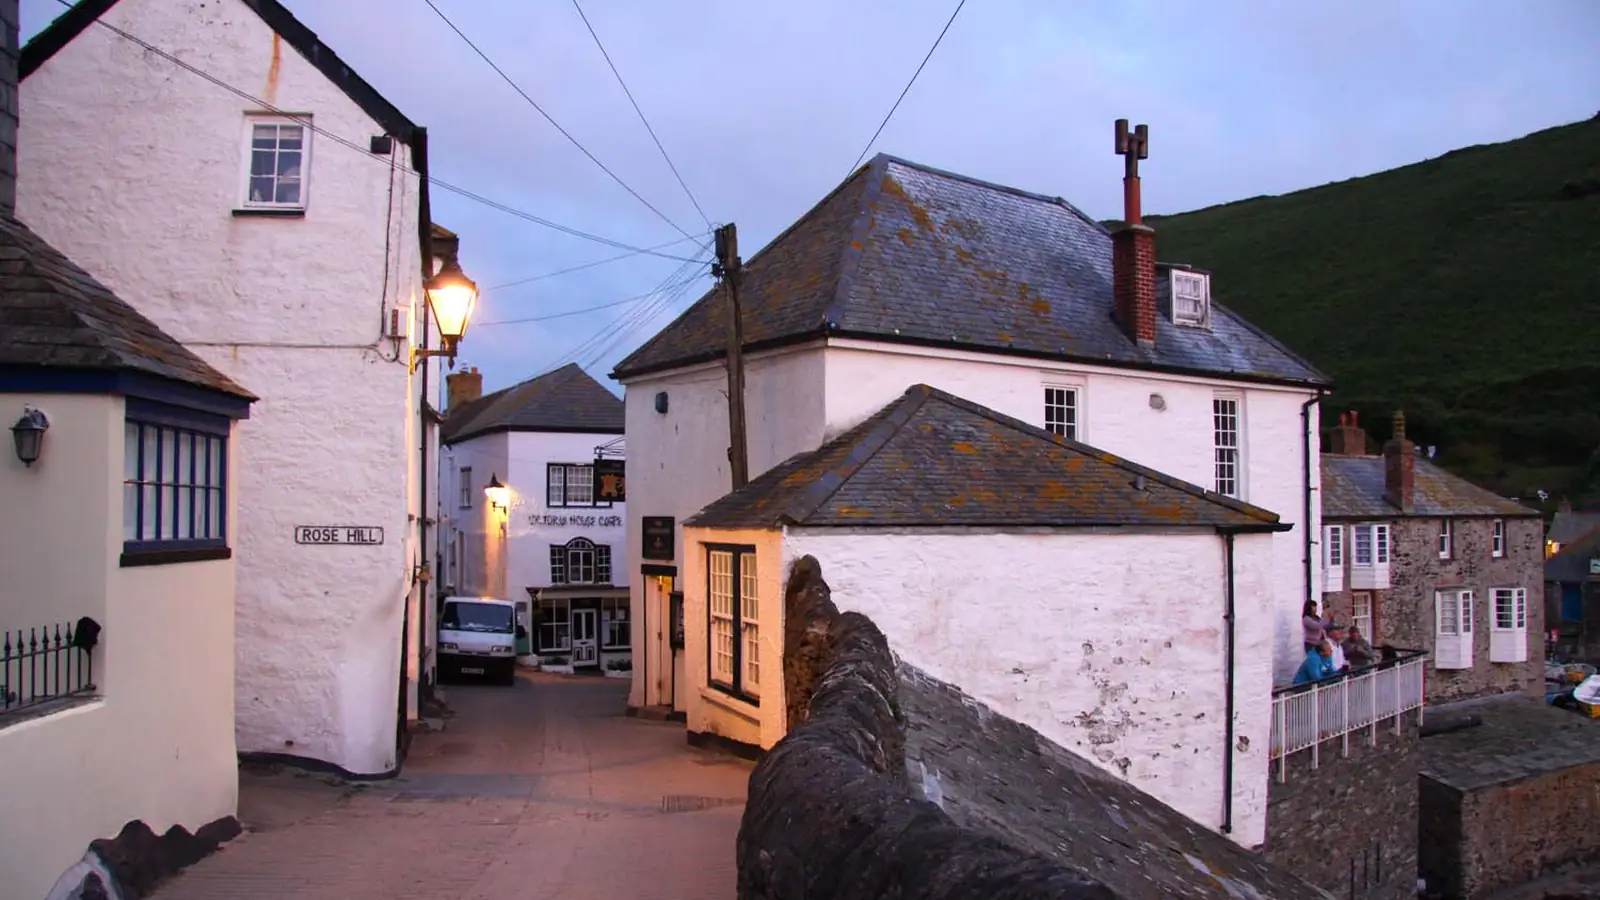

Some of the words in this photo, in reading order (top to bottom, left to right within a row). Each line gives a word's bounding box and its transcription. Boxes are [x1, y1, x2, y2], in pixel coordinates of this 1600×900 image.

[569, 514, 596, 527] HOUSE
[302, 529, 339, 542] ROSE
[347, 529, 377, 542] HILL
